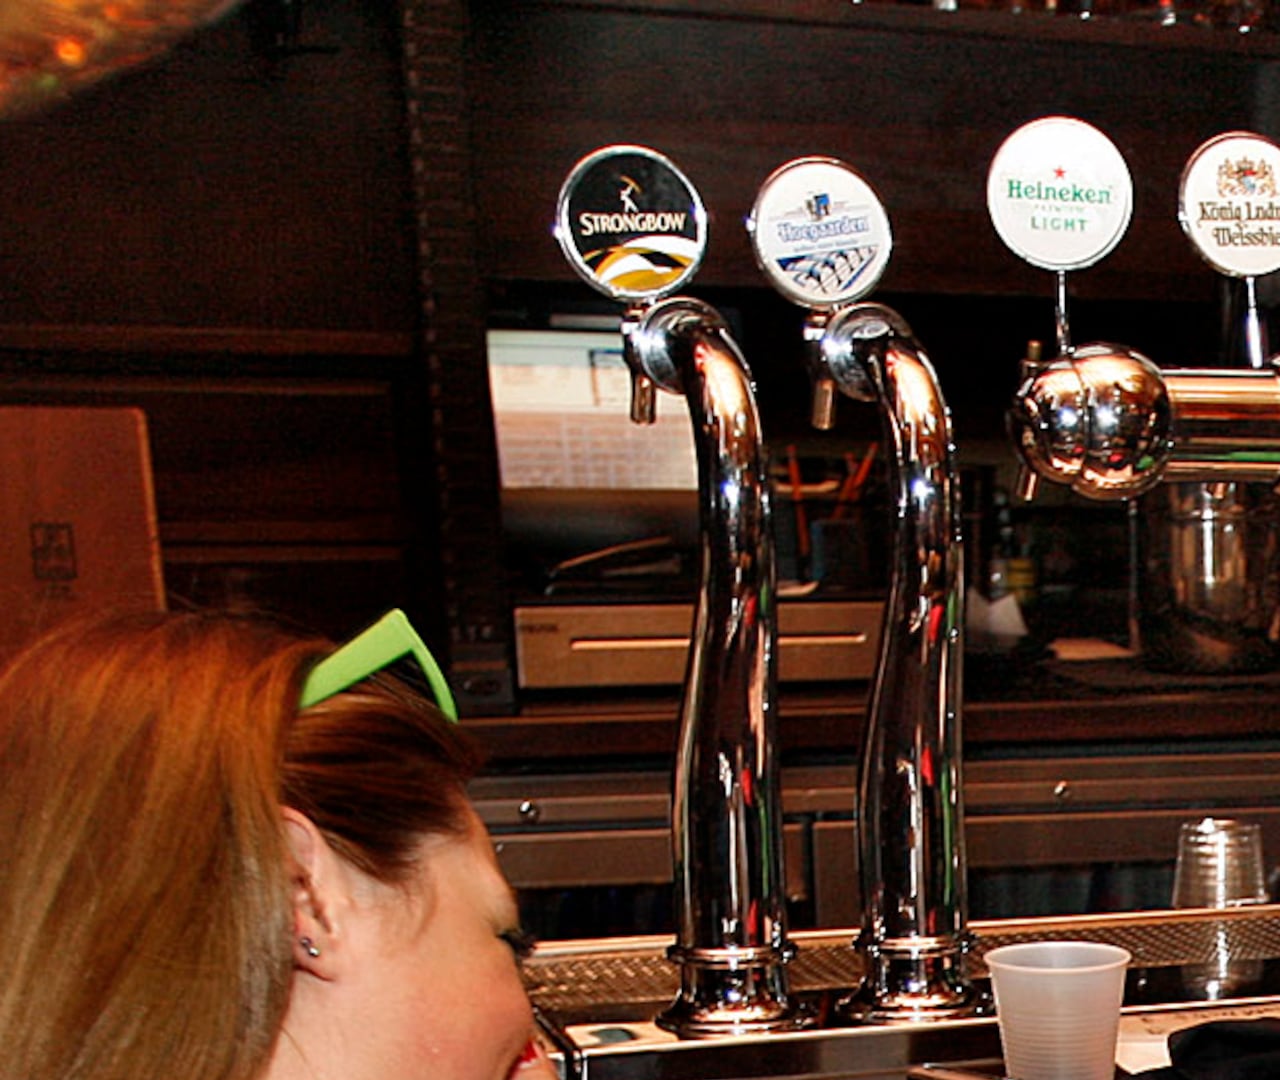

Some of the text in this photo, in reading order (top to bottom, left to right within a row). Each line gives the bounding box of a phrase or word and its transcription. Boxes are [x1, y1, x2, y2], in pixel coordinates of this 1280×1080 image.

[1007, 179, 1111, 204] Heineken
[579, 212, 687, 237] STRONGBOW
[1031, 215, 1088, 232] LIGHT
